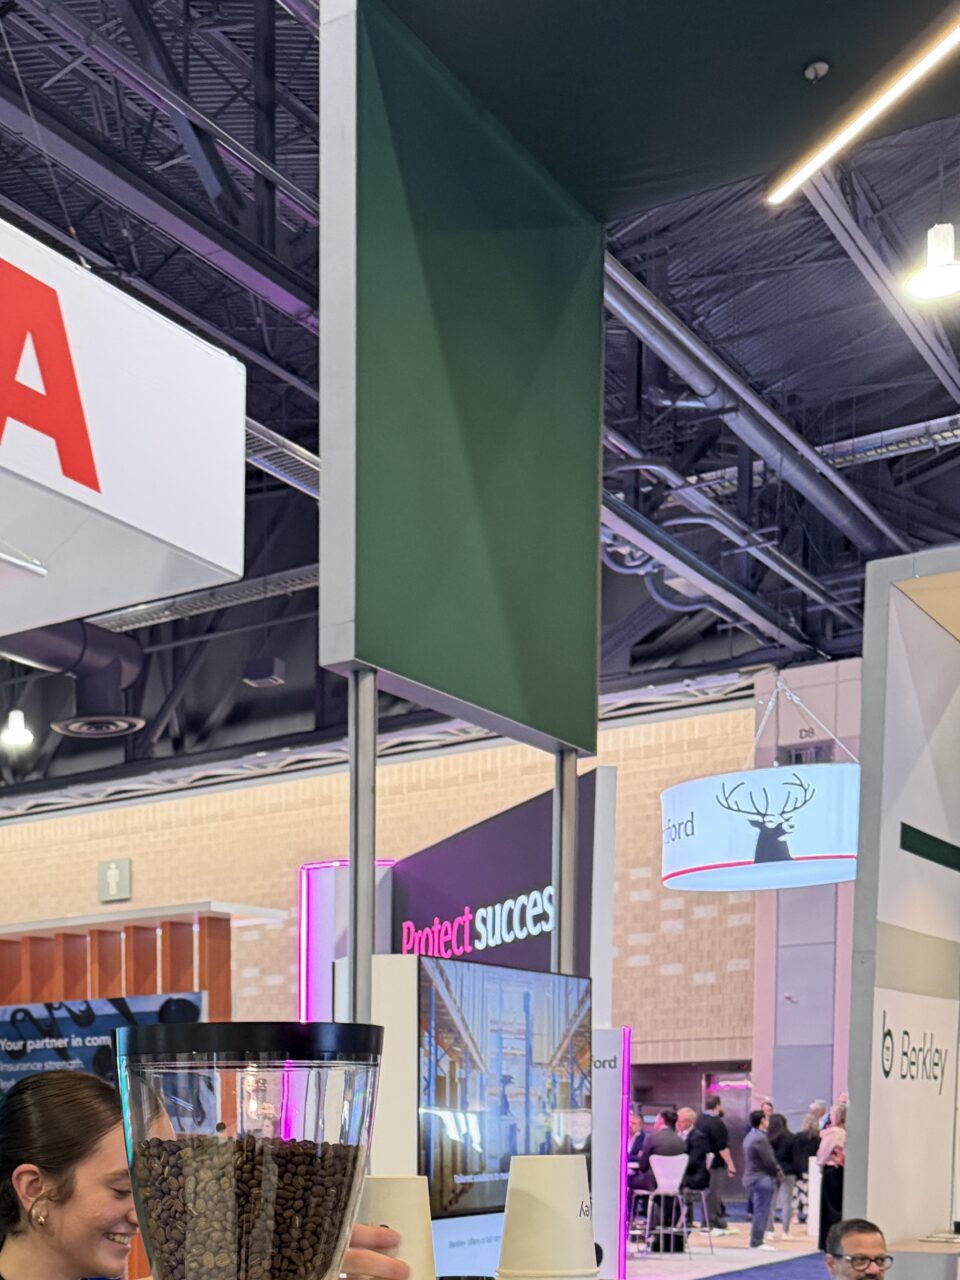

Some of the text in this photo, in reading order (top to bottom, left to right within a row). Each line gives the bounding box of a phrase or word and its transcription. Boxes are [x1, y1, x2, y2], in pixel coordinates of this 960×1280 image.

[401, 906, 473, 959] Protect
[0, 1034, 112, 1053] Your partner in com
[900, 1030, 948, 1096] Berkley
